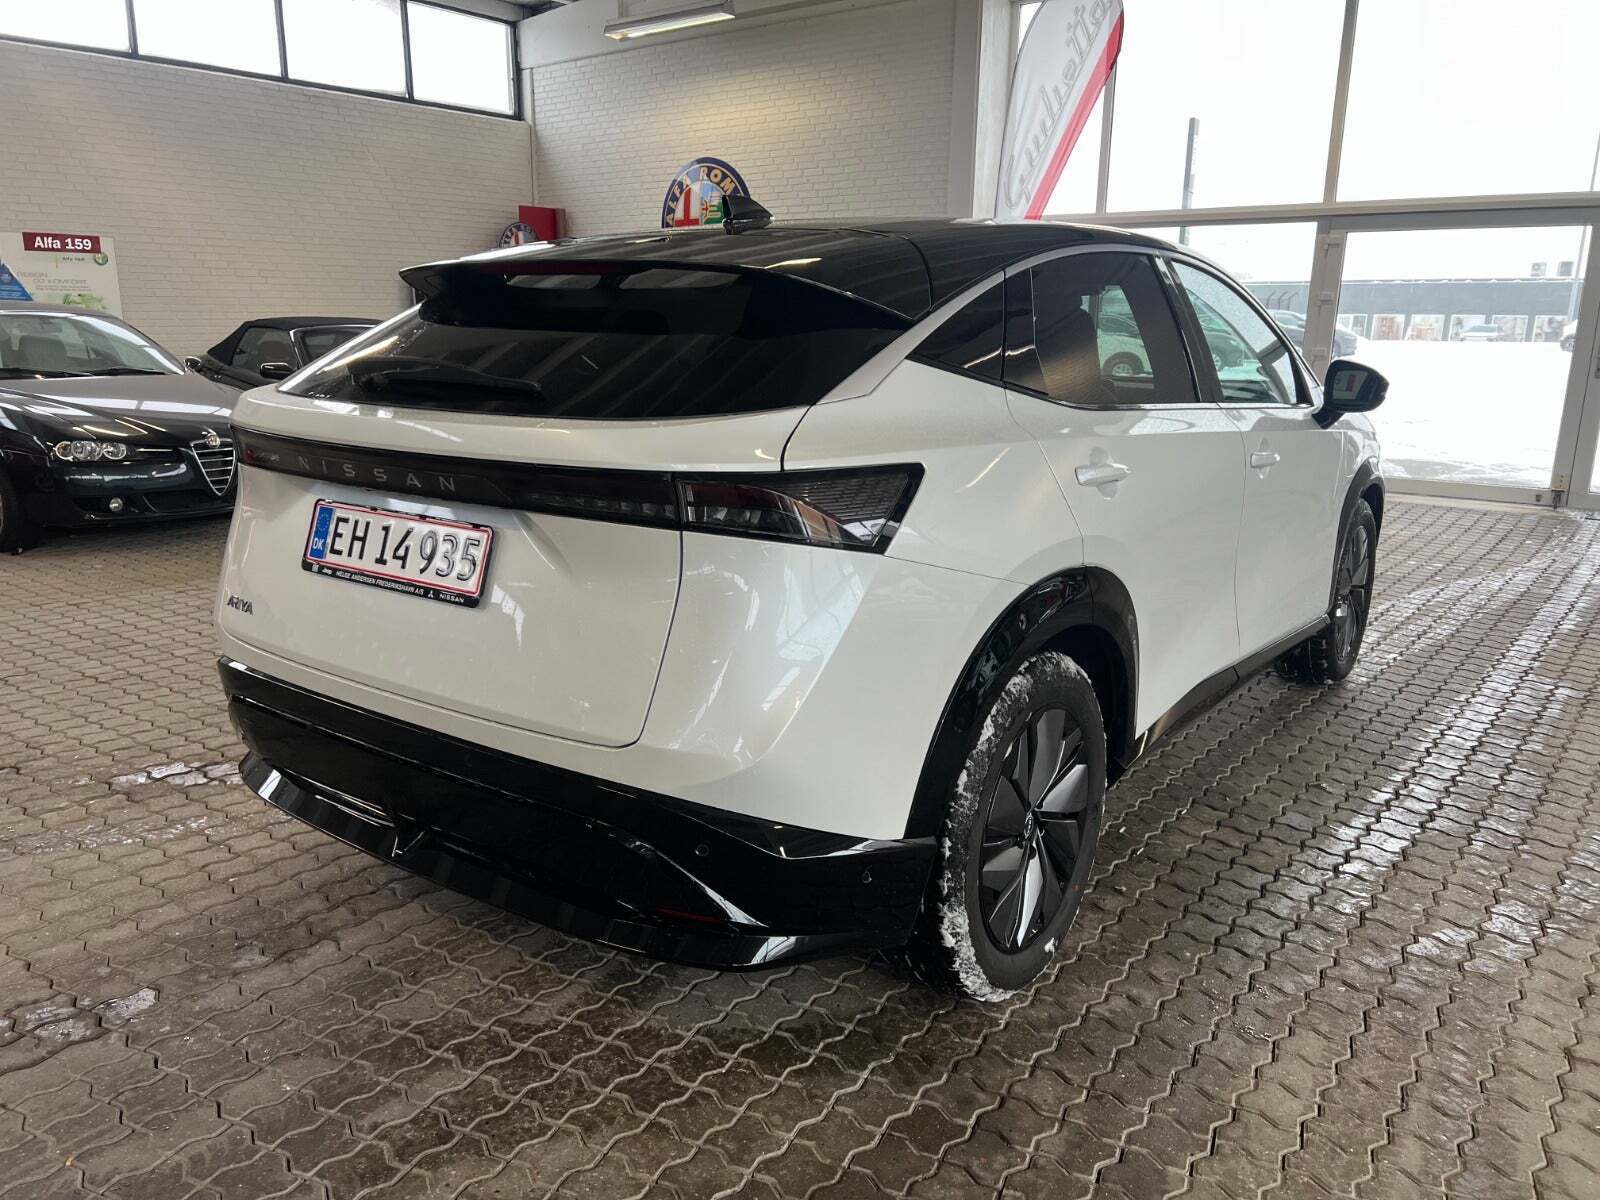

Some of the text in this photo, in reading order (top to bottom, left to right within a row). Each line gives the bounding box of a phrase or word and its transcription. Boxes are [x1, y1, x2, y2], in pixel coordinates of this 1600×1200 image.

[700, 166, 736, 194] ROM
[34, 236, 92, 250] Alfa 159
[297, 455, 456, 492] NISSAN
[312, 537, 324, 551] DK
[329, 516, 371, 560] EH
[440, 593, 465, 603] NISSAN
